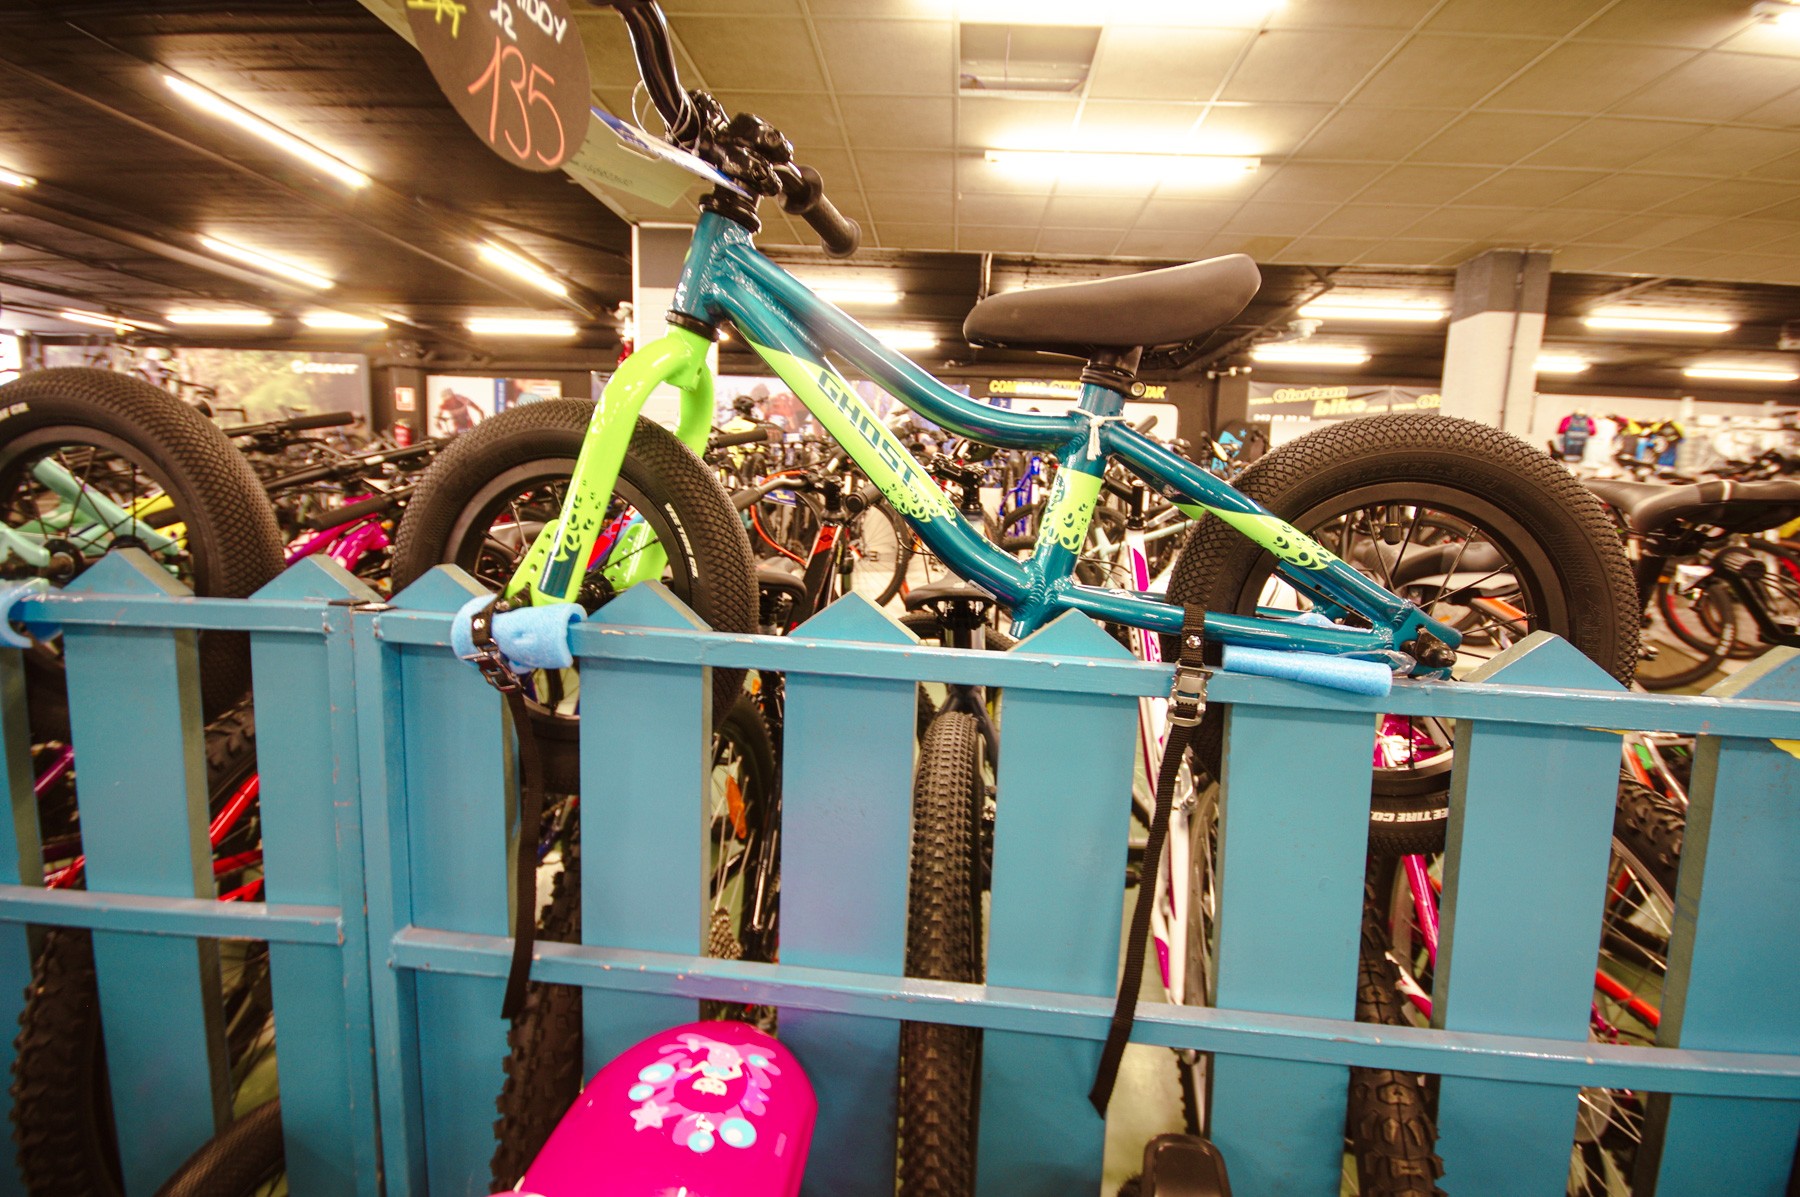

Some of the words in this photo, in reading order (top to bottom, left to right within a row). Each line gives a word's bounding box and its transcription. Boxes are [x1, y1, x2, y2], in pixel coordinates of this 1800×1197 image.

[516, 0, 567, 44] DDY
[467, 36, 566, 168] 135
[817, 370, 919, 487] GHOST
[1396, 811, 1433, 823] TIRE
